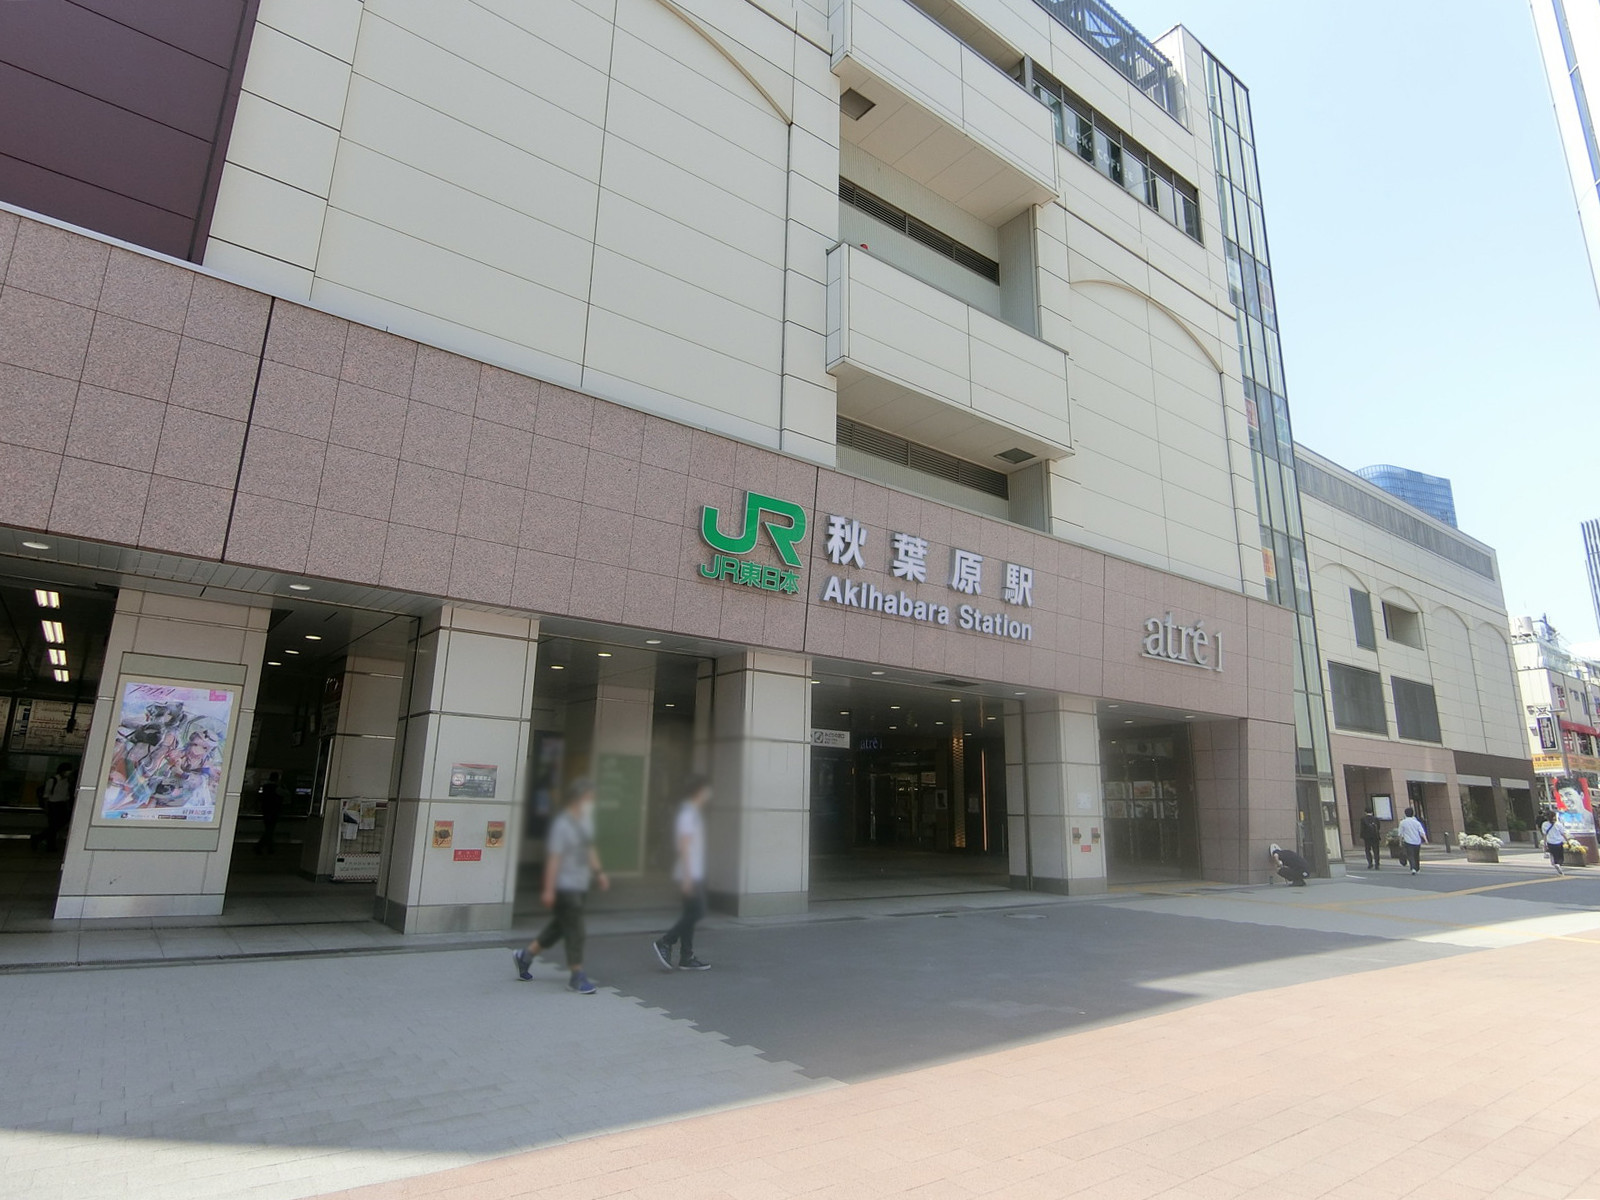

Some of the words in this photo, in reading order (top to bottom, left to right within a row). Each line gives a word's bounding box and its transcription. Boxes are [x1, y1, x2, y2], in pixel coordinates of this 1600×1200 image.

[701, 491, 807, 568] JR
[825, 514, 1035, 608] 秋葉原駅
[700, 554, 800, 594] JR東日本
[822, 575, 951, 627] Akihabara
[958, 603, 1034, 642] Station
[1143, 611, 1209, 665] atré
